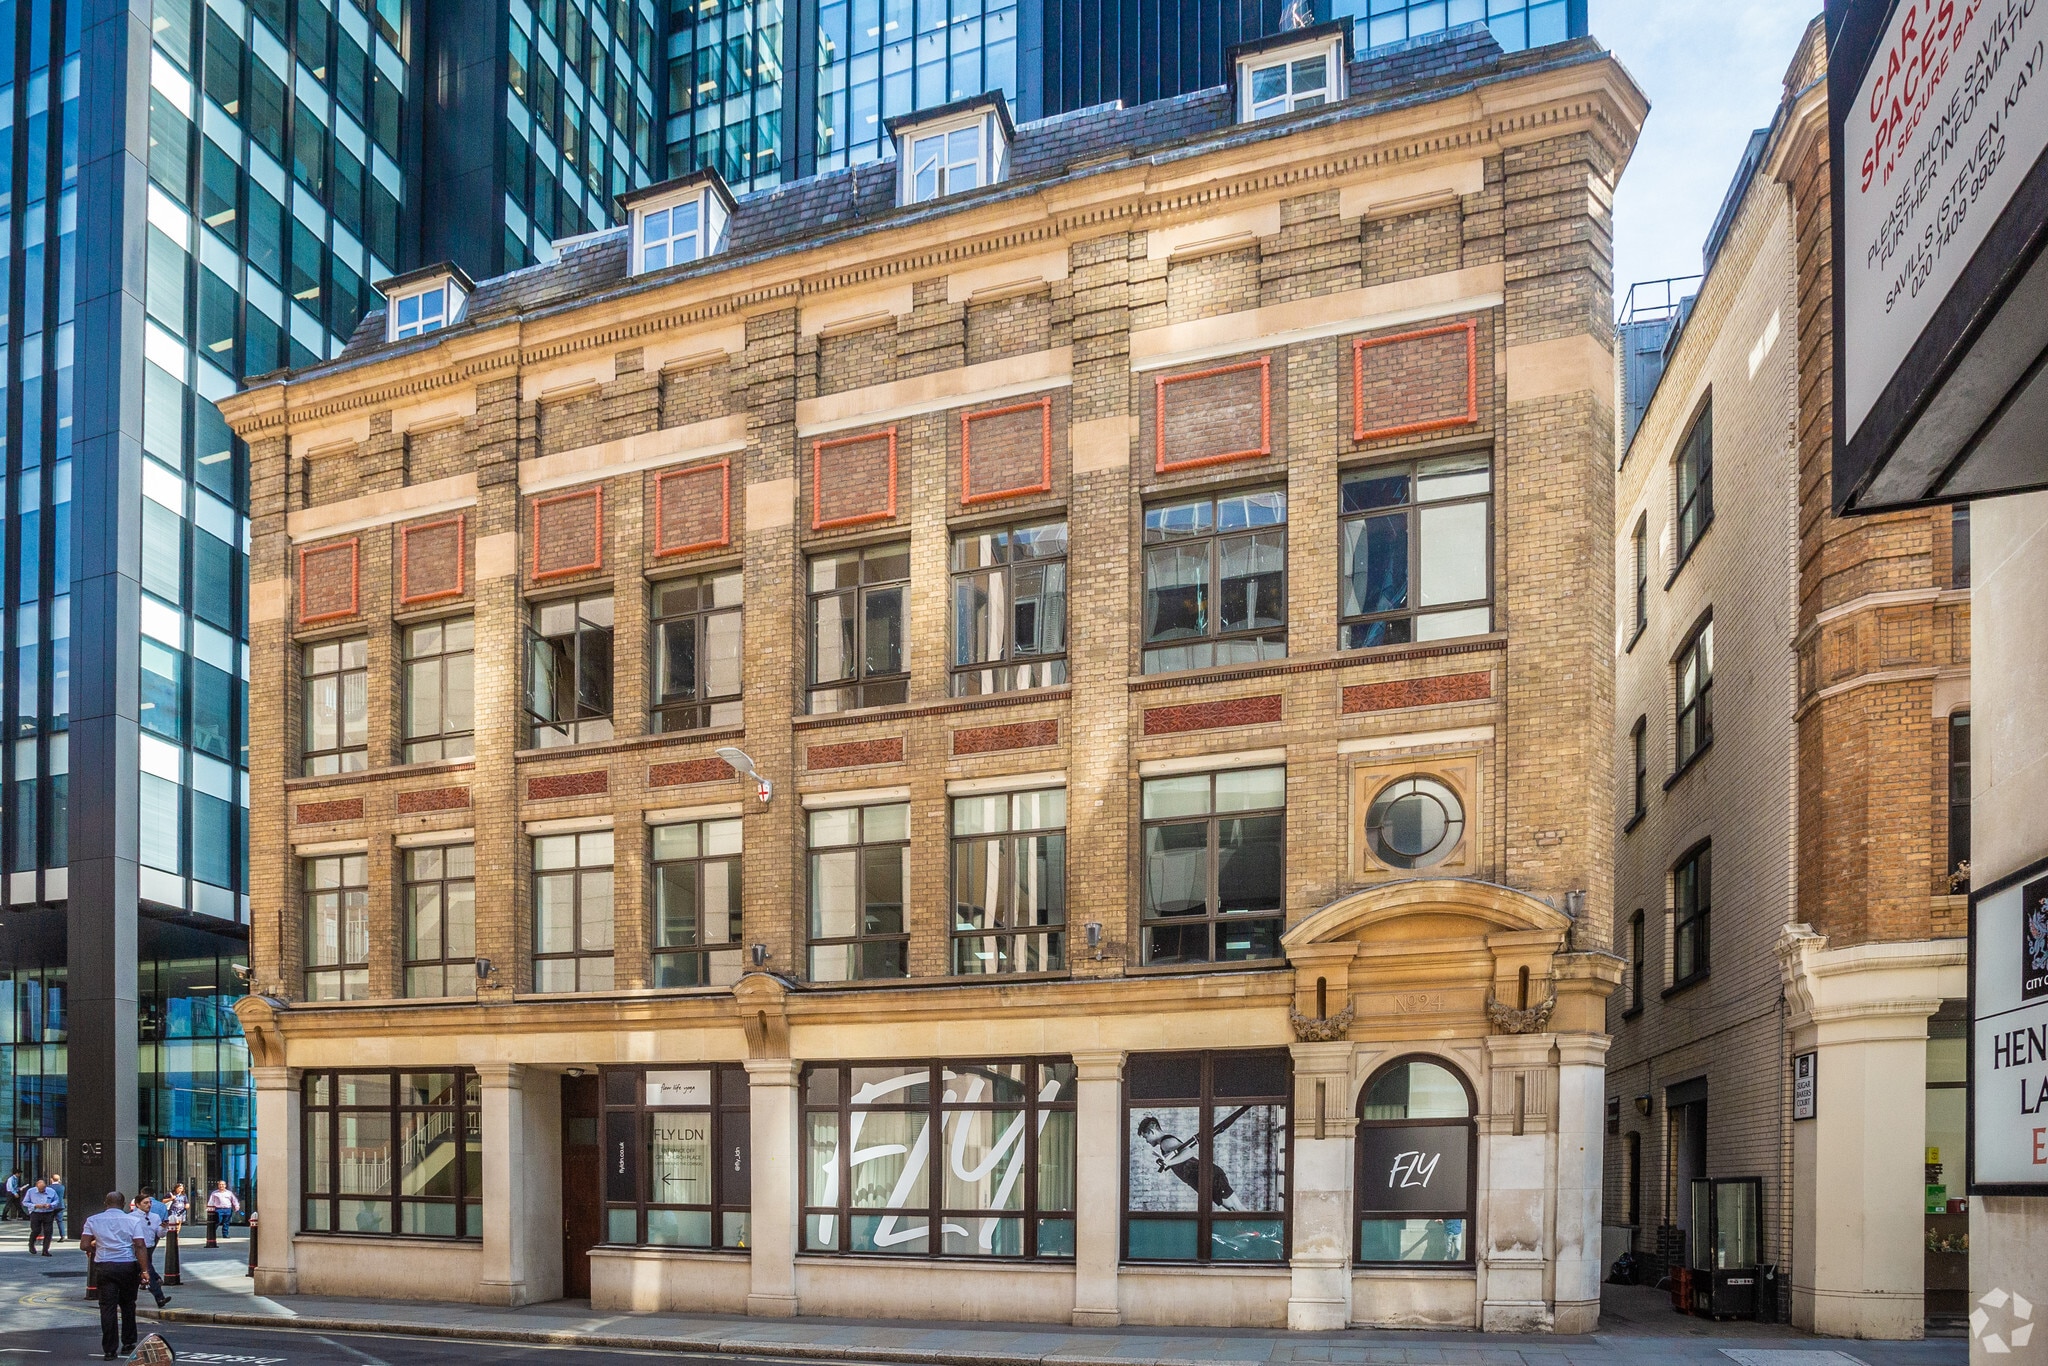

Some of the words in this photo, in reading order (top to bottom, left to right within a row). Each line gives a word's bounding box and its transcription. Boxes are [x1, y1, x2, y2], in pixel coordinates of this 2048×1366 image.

[1861, 0, 1954, 193] SPACES
[1870, 5, 1918, 123] CAR
[1883, 159, 1895, 186] IN
[1897, 46, 1949, 159] SECURE
[1867, 178, 1911, 270] PLEASE
[1913, 87, 1960, 183] PHONE
[1881, 162, 1937, 271] FURTHER
[1886, 225, 1934, 314] SAVILLS
[1936, 111, 2000, 233] (STEVEN
[2004, 40, 2044, 119] KAY)
[1911, 260, 1933, 299] 020
[1935, 197, 1967, 259] 7409
[1971, 135, 2006, 204] 9982
[1418, 993, 1444, 1013] 24
[2026, 976, 2043, 991] CITY
[1994, 1023, 2047, 1070] HEN
[81, 1142, 102, 1154] ONE
[654, 1129, 675, 1140] FLY
[677, 1129, 704, 1140] LDN
[1388, 1150, 1441, 1188] FLY
